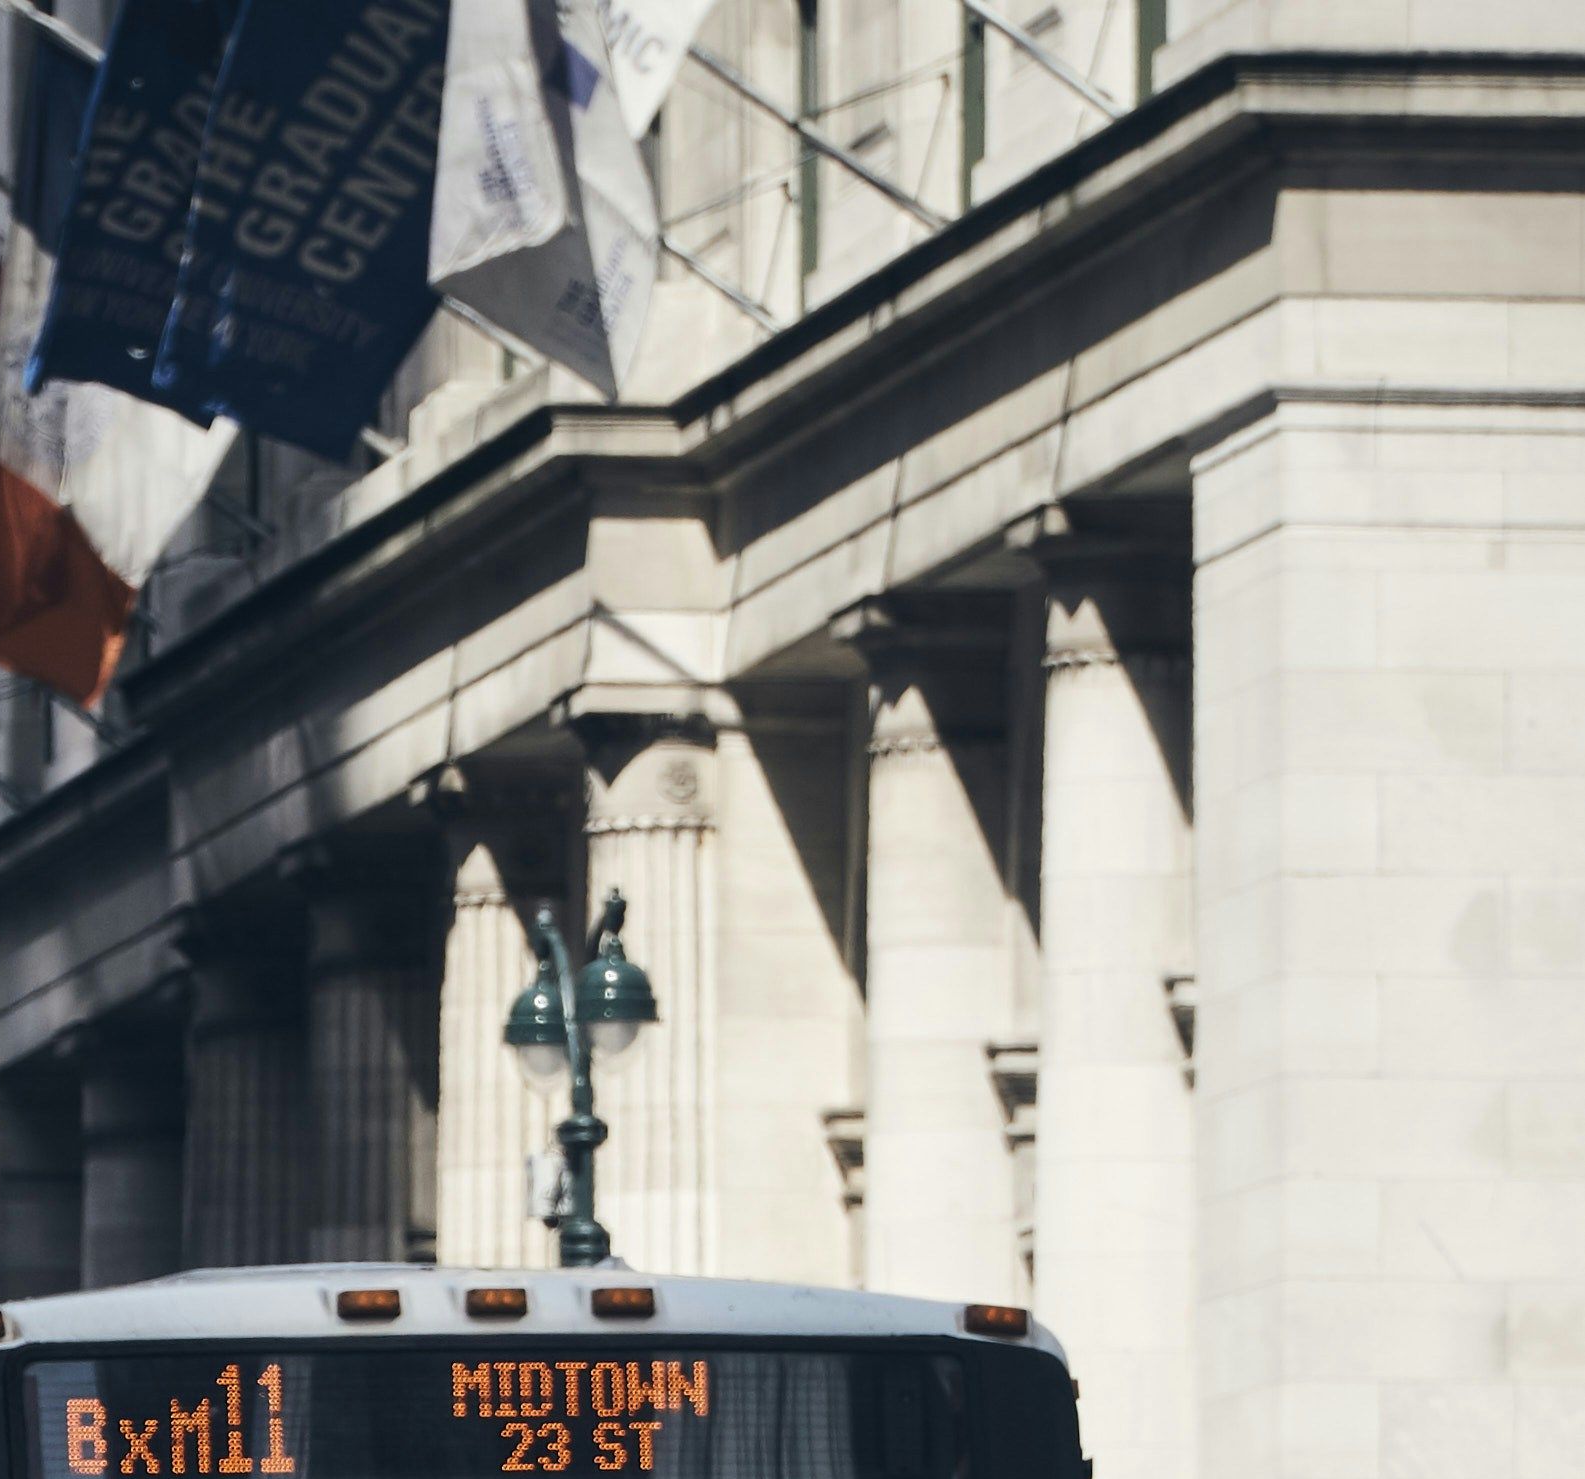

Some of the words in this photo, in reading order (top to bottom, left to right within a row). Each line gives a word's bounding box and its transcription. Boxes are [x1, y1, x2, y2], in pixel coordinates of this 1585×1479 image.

[233, 0, 445, 260] GRADUA
[452, 1360, 709, 1418] MIDTOWN
[500, 1422, 571, 1471] 23
[592, 1422, 662, 1471] ST
